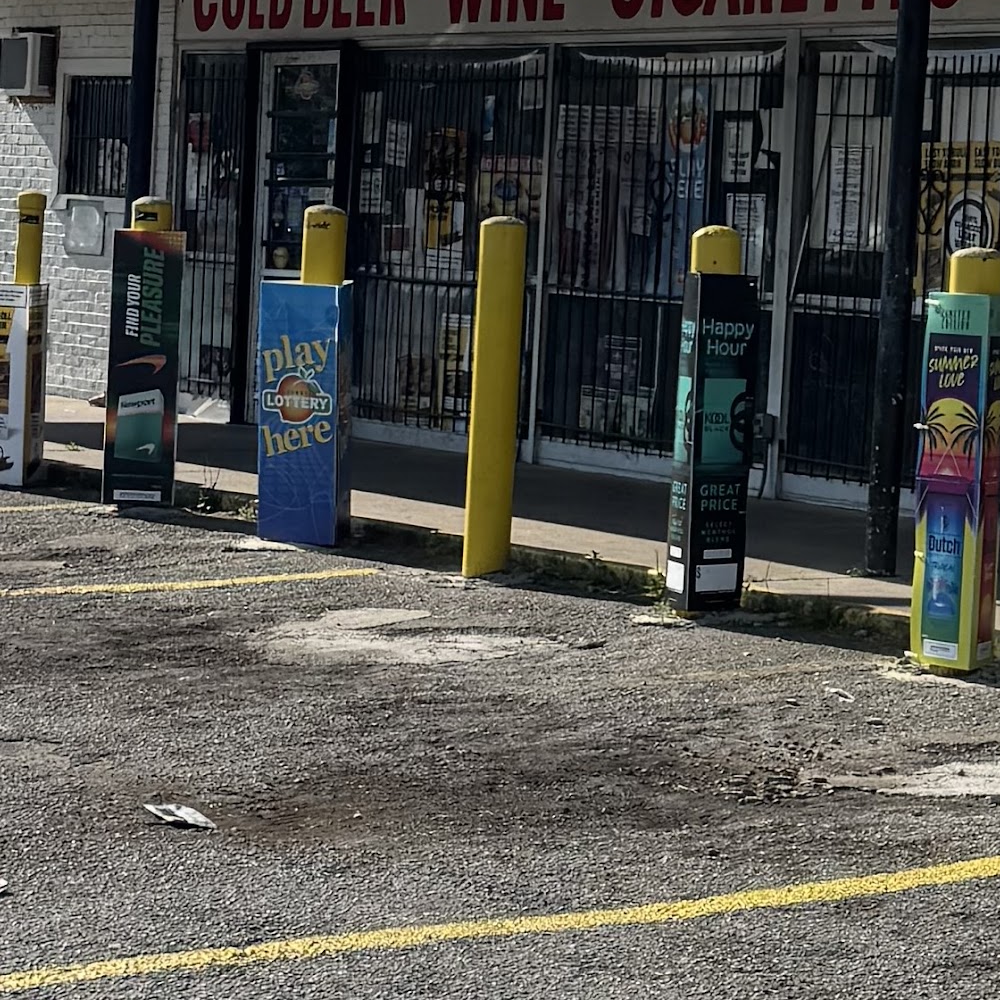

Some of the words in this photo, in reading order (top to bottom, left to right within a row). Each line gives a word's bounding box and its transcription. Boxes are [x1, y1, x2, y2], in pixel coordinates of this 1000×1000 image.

[126, 273, 142, 307] YOUR
[139, 246, 165, 348] PLEASURE
[124, 306, 140, 338] FIND
[702, 317, 755, 341] Happy
[706, 338, 748, 357] Hour
[262, 334, 331, 384] play
[266, 393, 330, 410] LOTTERY
[704, 412, 729, 424] KOOL
[259, 420, 333, 458] here
[700, 482, 741, 497] GREAT
[700, 497, 739, 512] PRICE
[928, 534, 960, 555] Dutch
